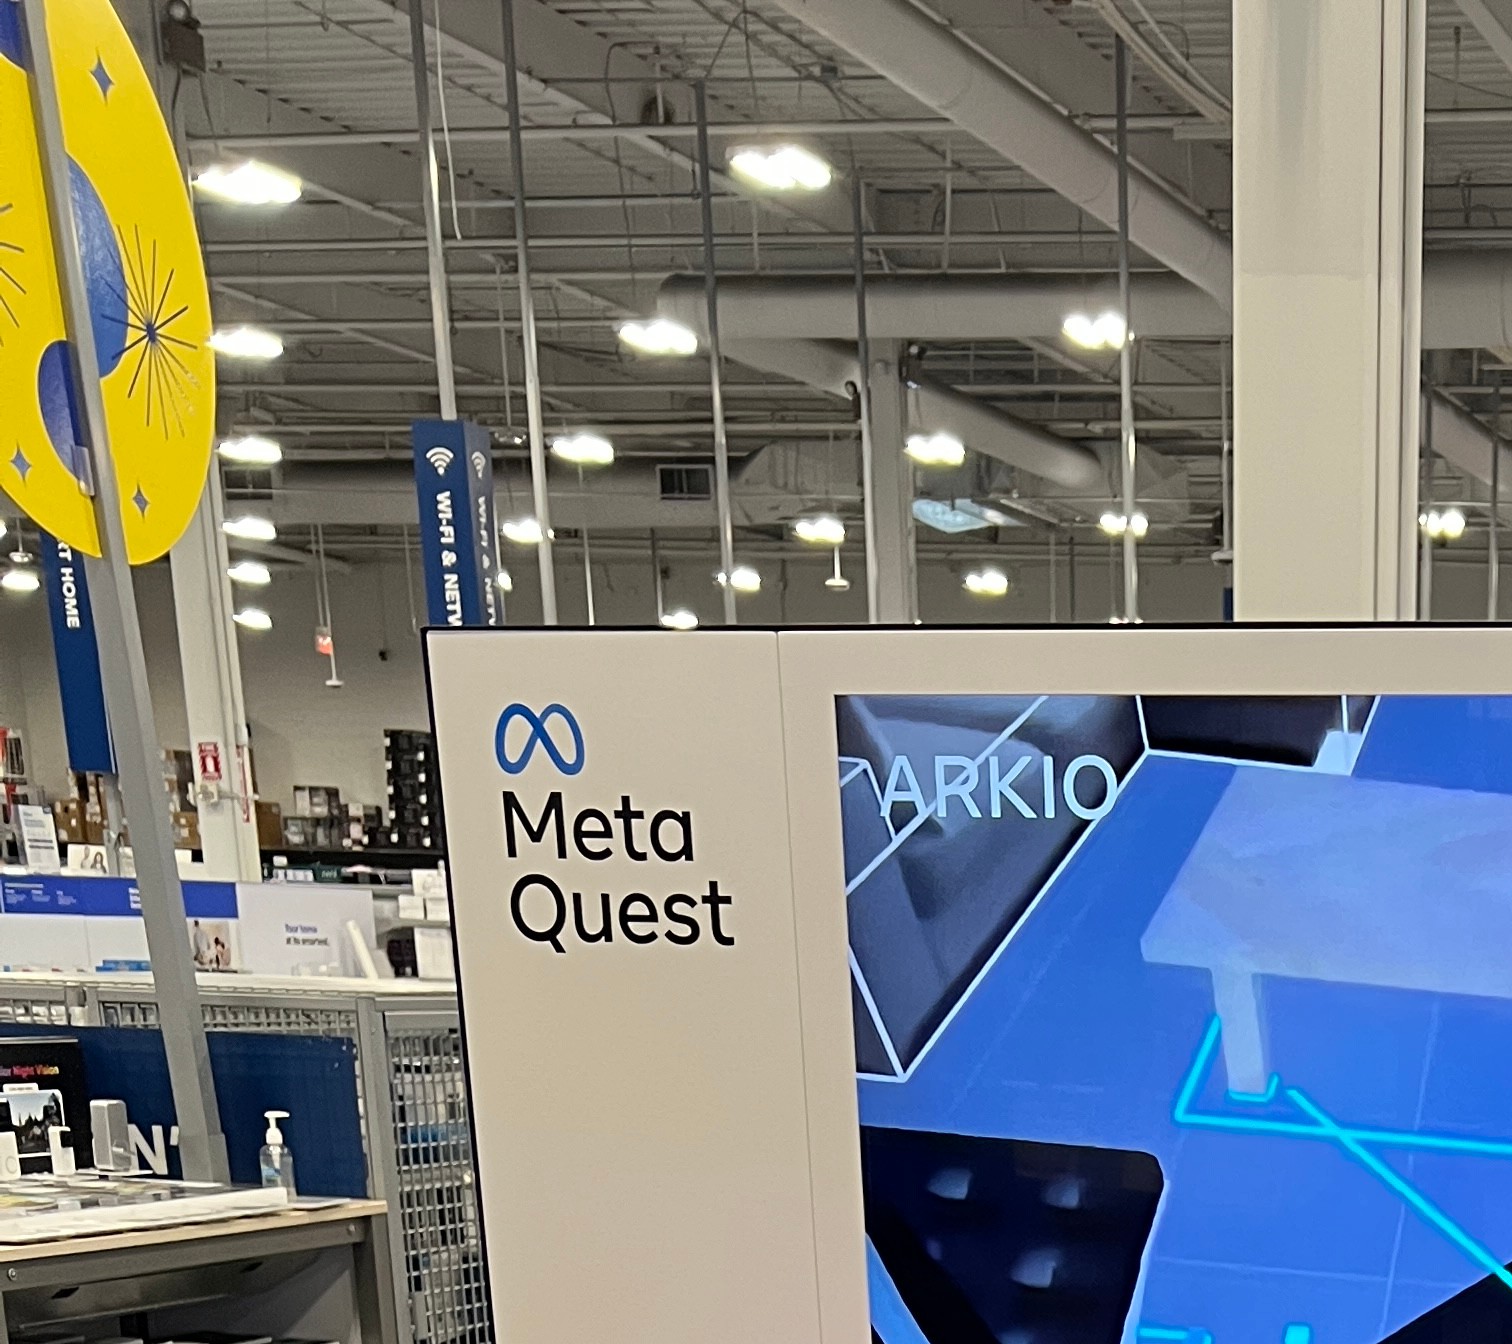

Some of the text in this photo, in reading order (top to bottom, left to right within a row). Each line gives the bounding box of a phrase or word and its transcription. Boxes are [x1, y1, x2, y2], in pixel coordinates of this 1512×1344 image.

[436, 491, 455, 544] WI-FI
[441, 550, 457, 567] &
[60, 567, 81, 628] HOME
[880, 754, 1118, 820] ARKIO
[502, 790, 694, 862] Meta
[510, 873, 735, 953] Quest
